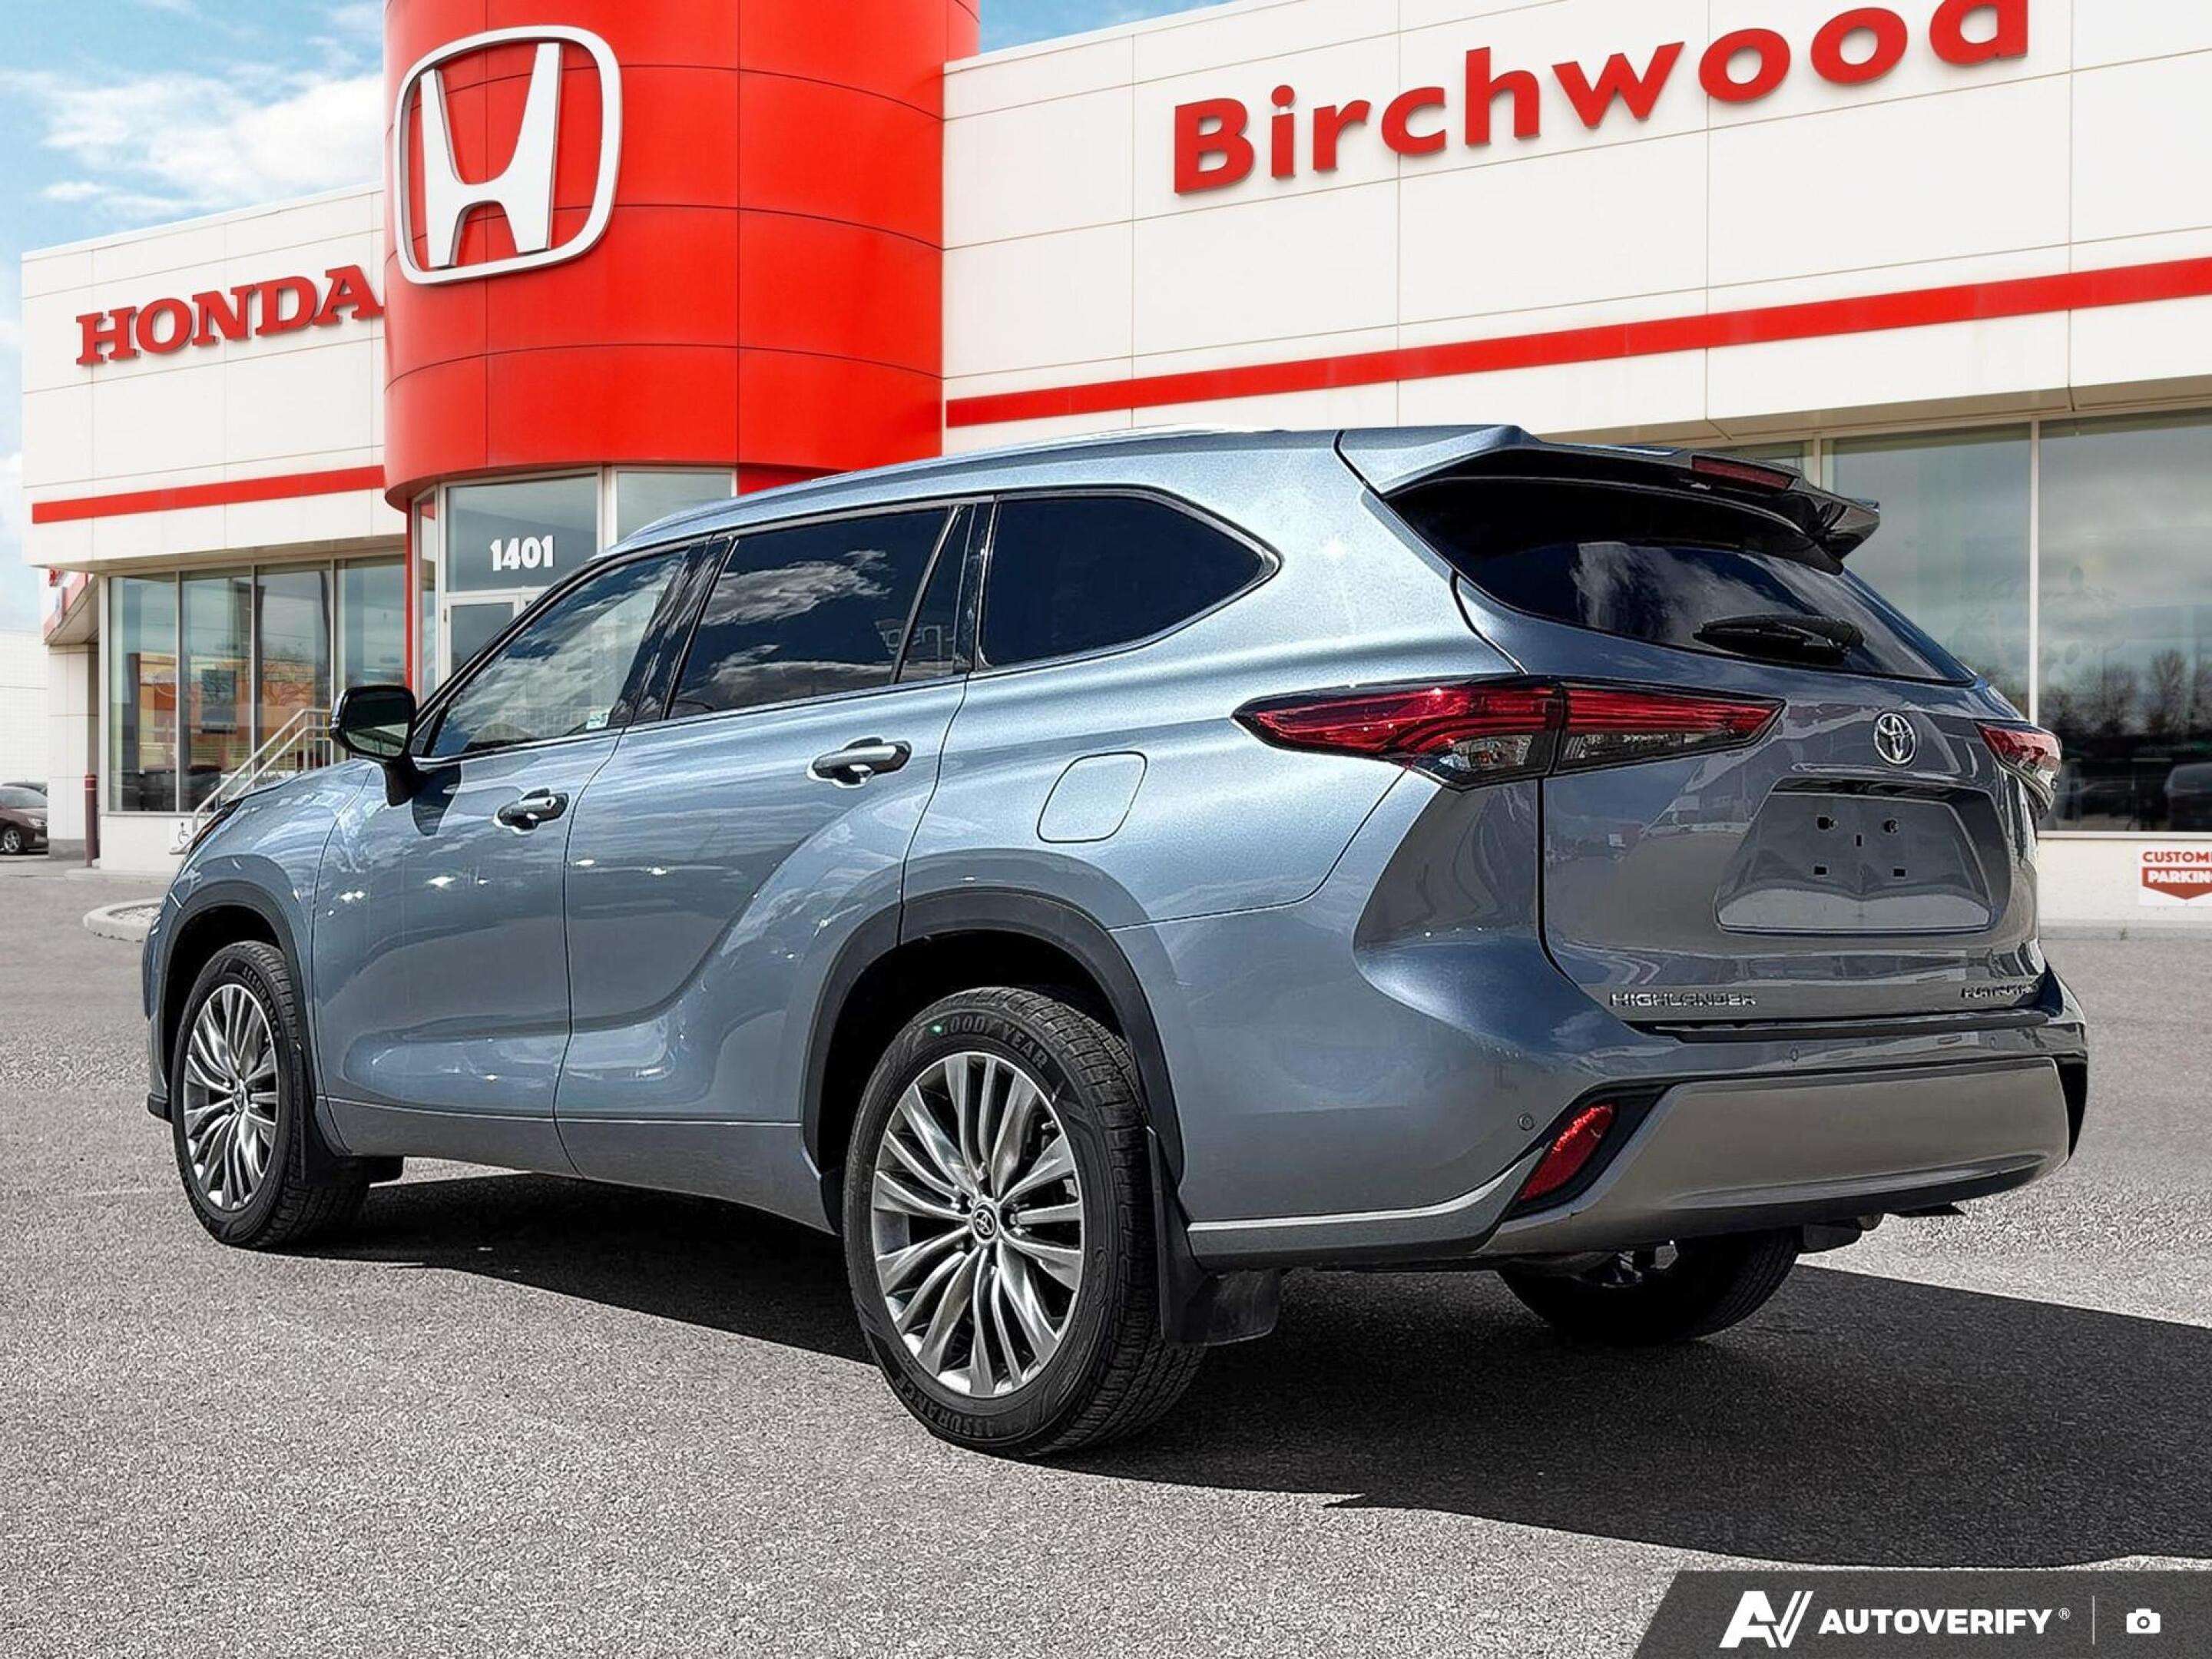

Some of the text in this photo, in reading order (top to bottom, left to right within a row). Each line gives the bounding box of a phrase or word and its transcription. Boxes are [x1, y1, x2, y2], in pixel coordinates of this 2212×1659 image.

[75, 264, 385, 366] HONDA
[489, 534, 554, 572] 1401
[2142, 851, 2212, 863] CUSTOM
[2147, 870, 2212, 883] PARKIN
[1609, 992, 1757, 1008] HIGHLANDER
